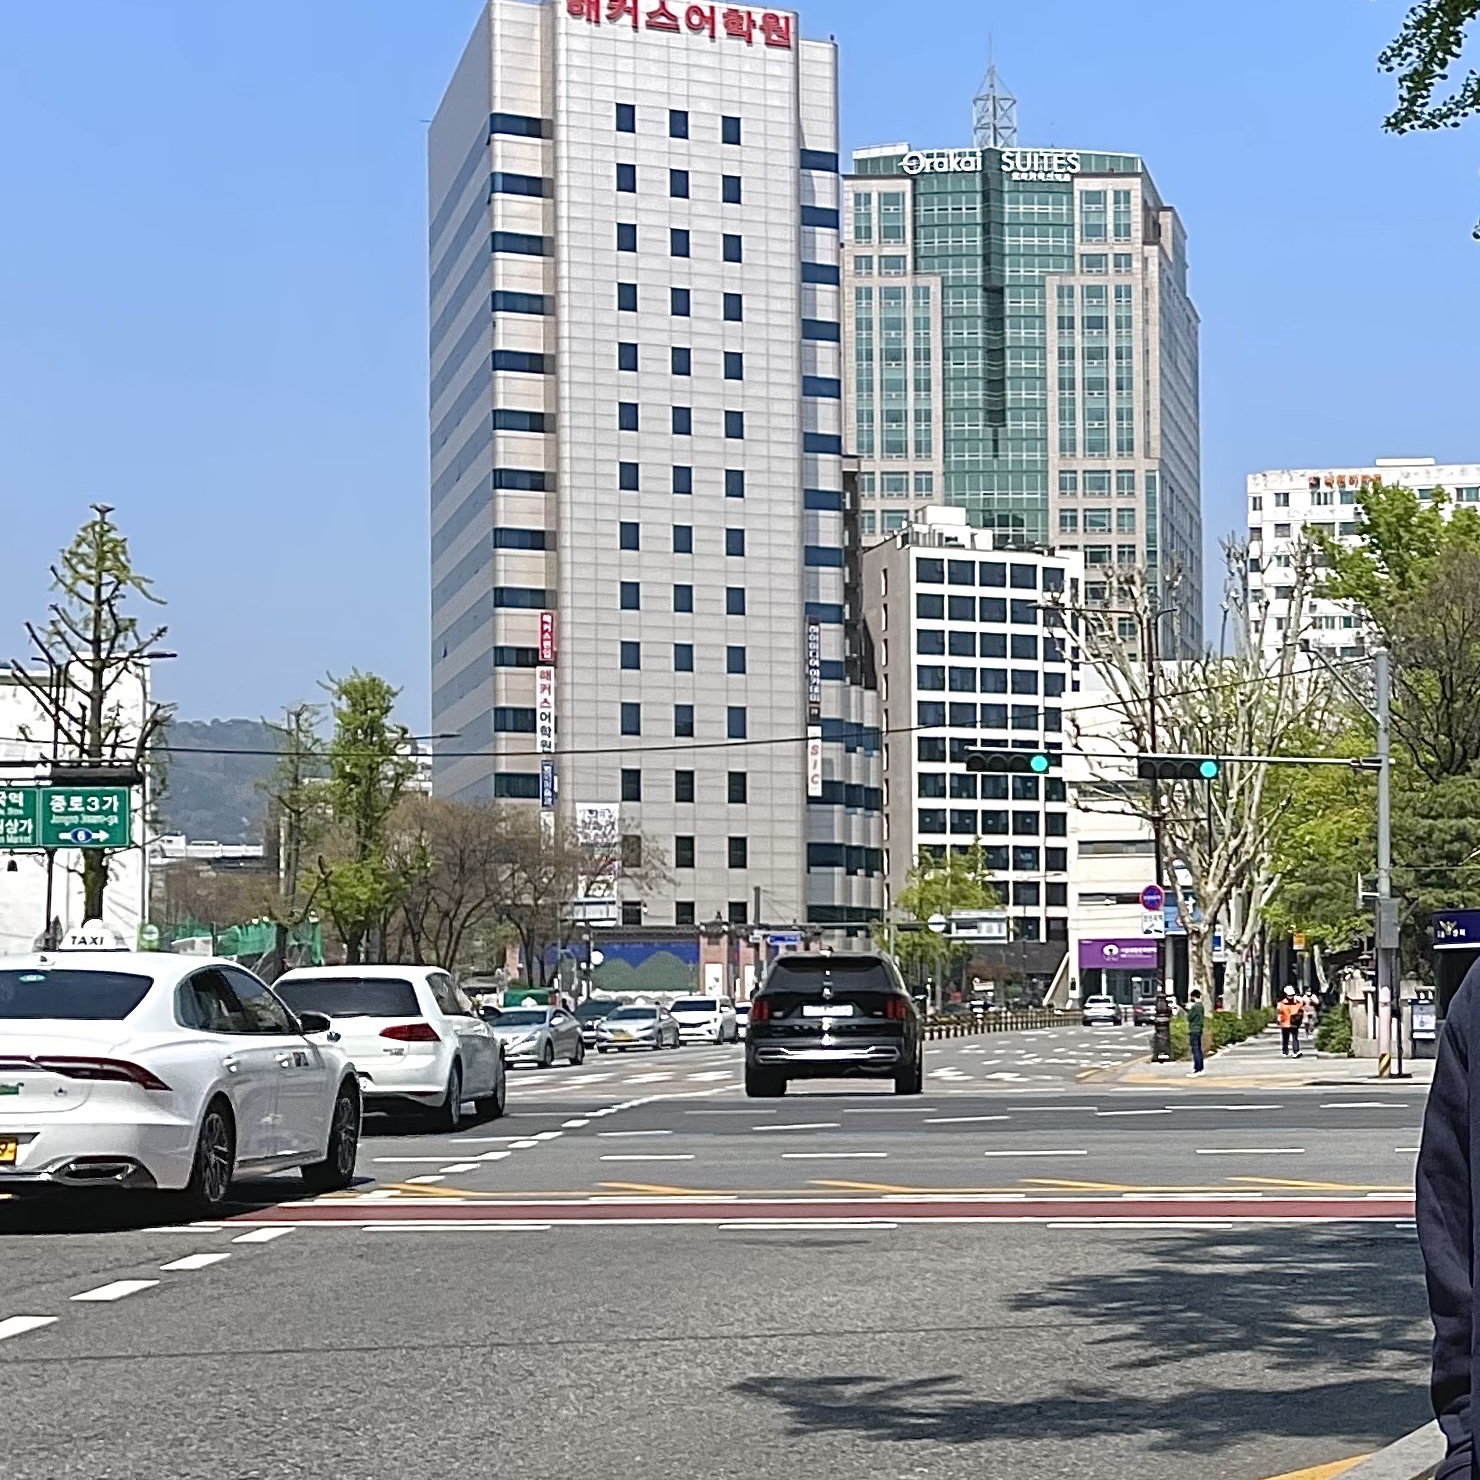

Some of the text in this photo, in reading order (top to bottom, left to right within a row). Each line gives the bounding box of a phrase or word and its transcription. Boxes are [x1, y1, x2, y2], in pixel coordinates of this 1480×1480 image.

[566, 0, 791, 49] 해커스어학원
[898, 150, 1081, 175] Orakai SUITES
[49, 794, 120, 813] 종로3가
[71, 935, 105, 946] TAXI
